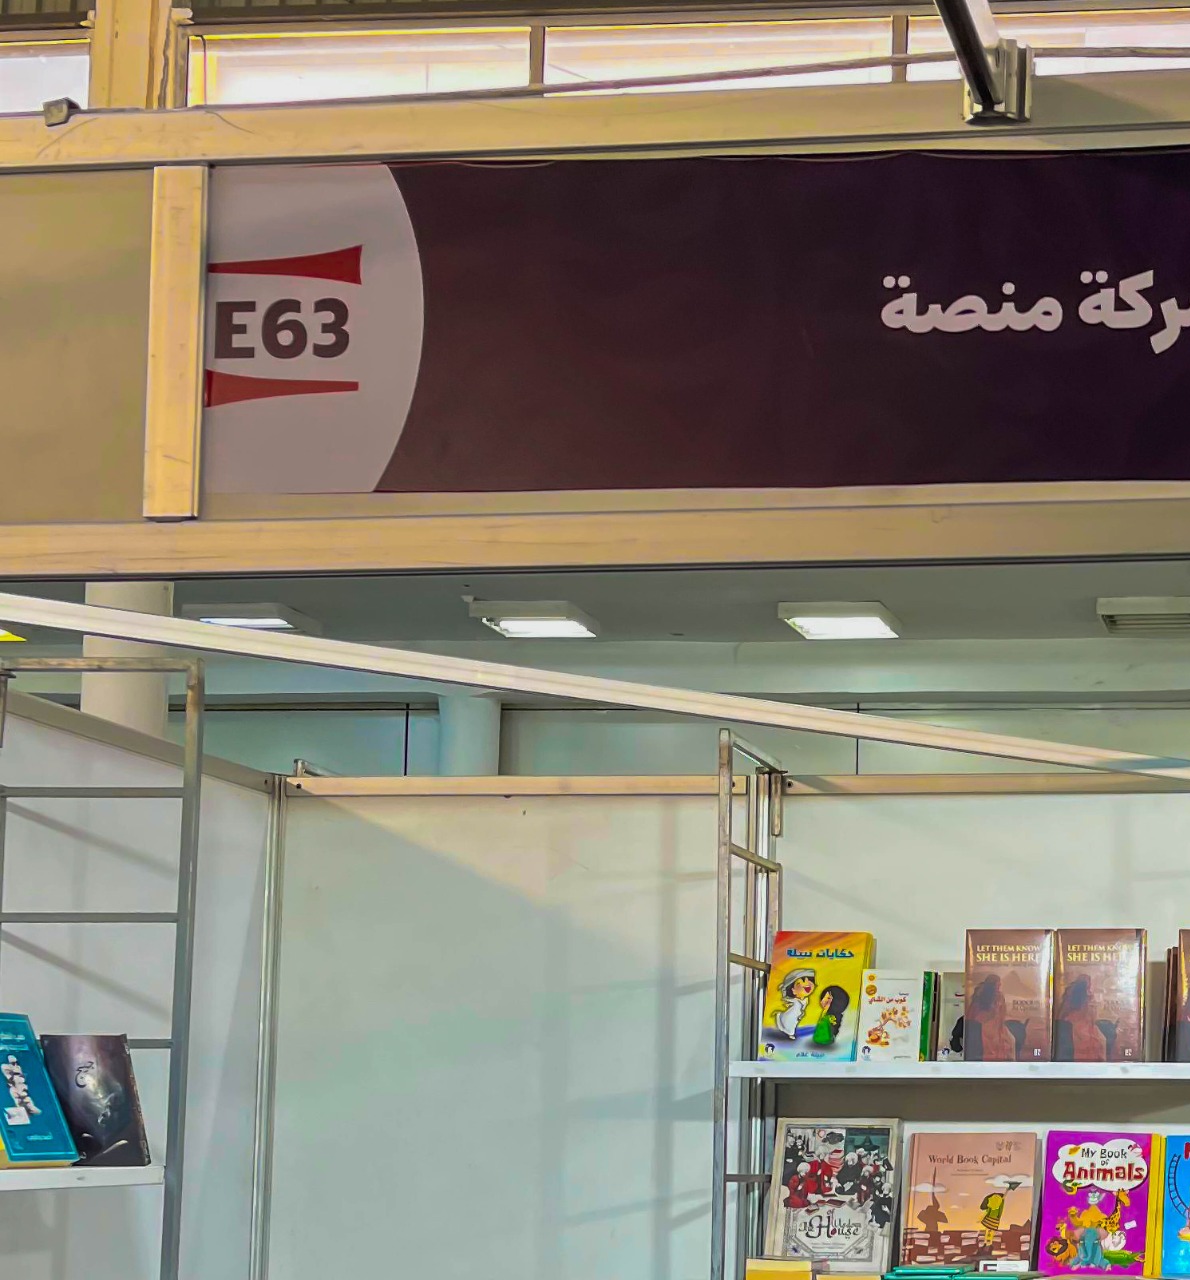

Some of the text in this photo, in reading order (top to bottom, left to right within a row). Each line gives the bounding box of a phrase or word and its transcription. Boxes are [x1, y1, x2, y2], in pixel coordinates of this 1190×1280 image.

[880, 274, 1063, 334] منصة
[214, 297, 350, 359] E63
[976, 952, 997, 962] SHE
[1000, 952, 1010, 962] IS
[1067, 952, 1088, 962] SHE
[1090, 952, 1100, 962] IS
[1081, 1147, 1128, 1160] My Book
[928, 1154, 1012, 1166] World Book Capital
[1100, 1158, 1109, 1166] of
[1062, 1161, 1145, 1182] Animals
